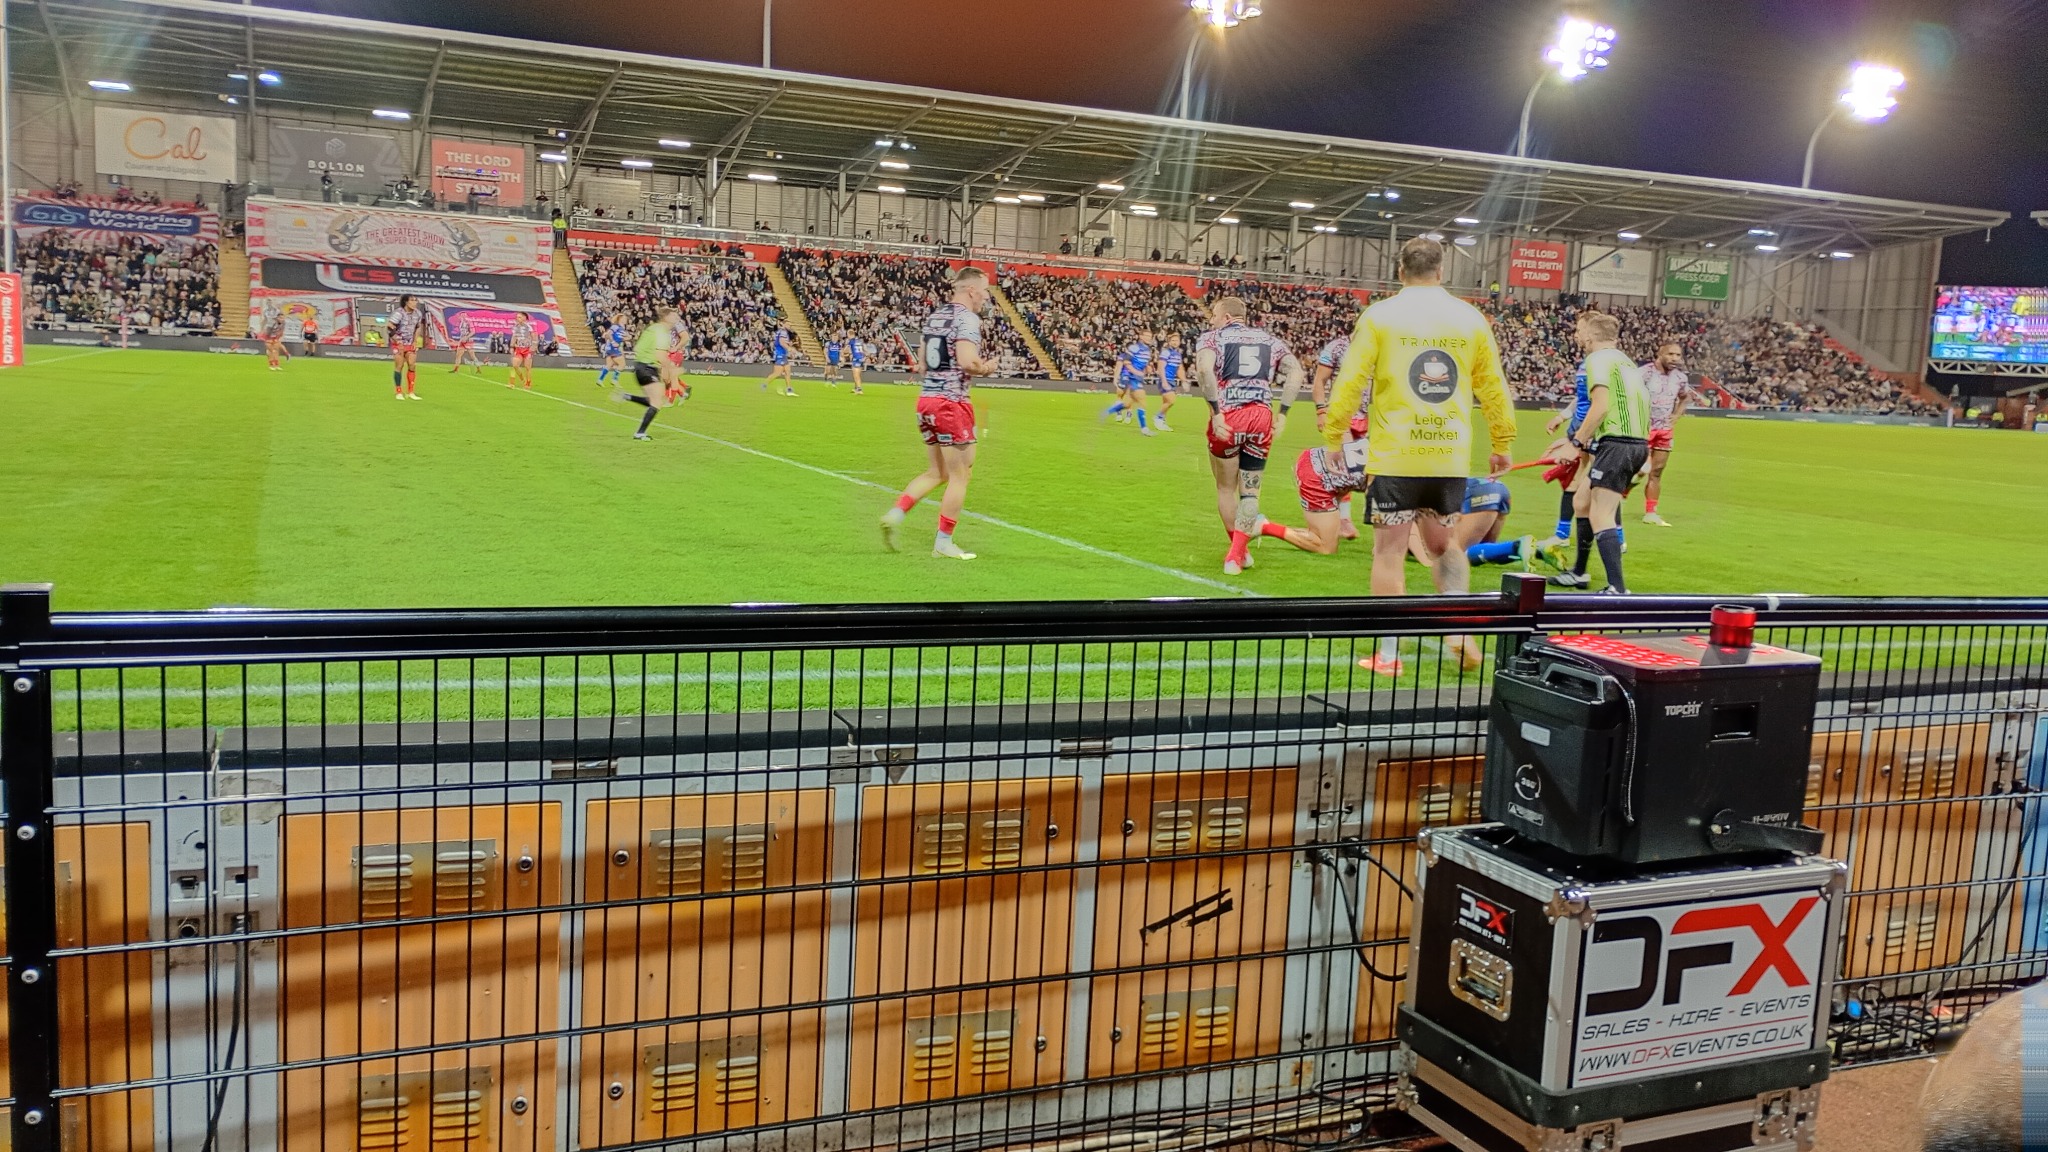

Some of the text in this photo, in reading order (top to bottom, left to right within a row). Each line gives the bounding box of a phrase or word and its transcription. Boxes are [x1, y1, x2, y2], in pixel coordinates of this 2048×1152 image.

[124, 117, 207, 161] Cal
[308, 159, 365, 173] BOLTON
[445, 151, 511, 167] THE LORD
[89, 209, 192, 227] Motoring
[89, 217, 159, 230] World
[367, 228, 445, 245] THE GREATEST SHOW
[1519, 248, 1558, 259] THE LORD
[1512, 259, 1563, 270] PETER SMITH
[398, 271, 435, 279] Civils
[1522, 271, 1550, 281] STAND
[400, 278, 490, 290] Groundworks
[925, 337, 942, 370] 6
[1238, 346, 1262, 377] 5
[1410, 429, 1458, 440] Market
[1664, 701, 1702, 716] TOPCAT
[1460, 892, 1508, 935] DFX
[1585, 896, 1820, 1017] DFX
[1582, 1018, 1650, 1040] SALES
[1669, 1007, 1723, 1027] HIRE
[1740, 995, 1811, 1016] EVENTS
